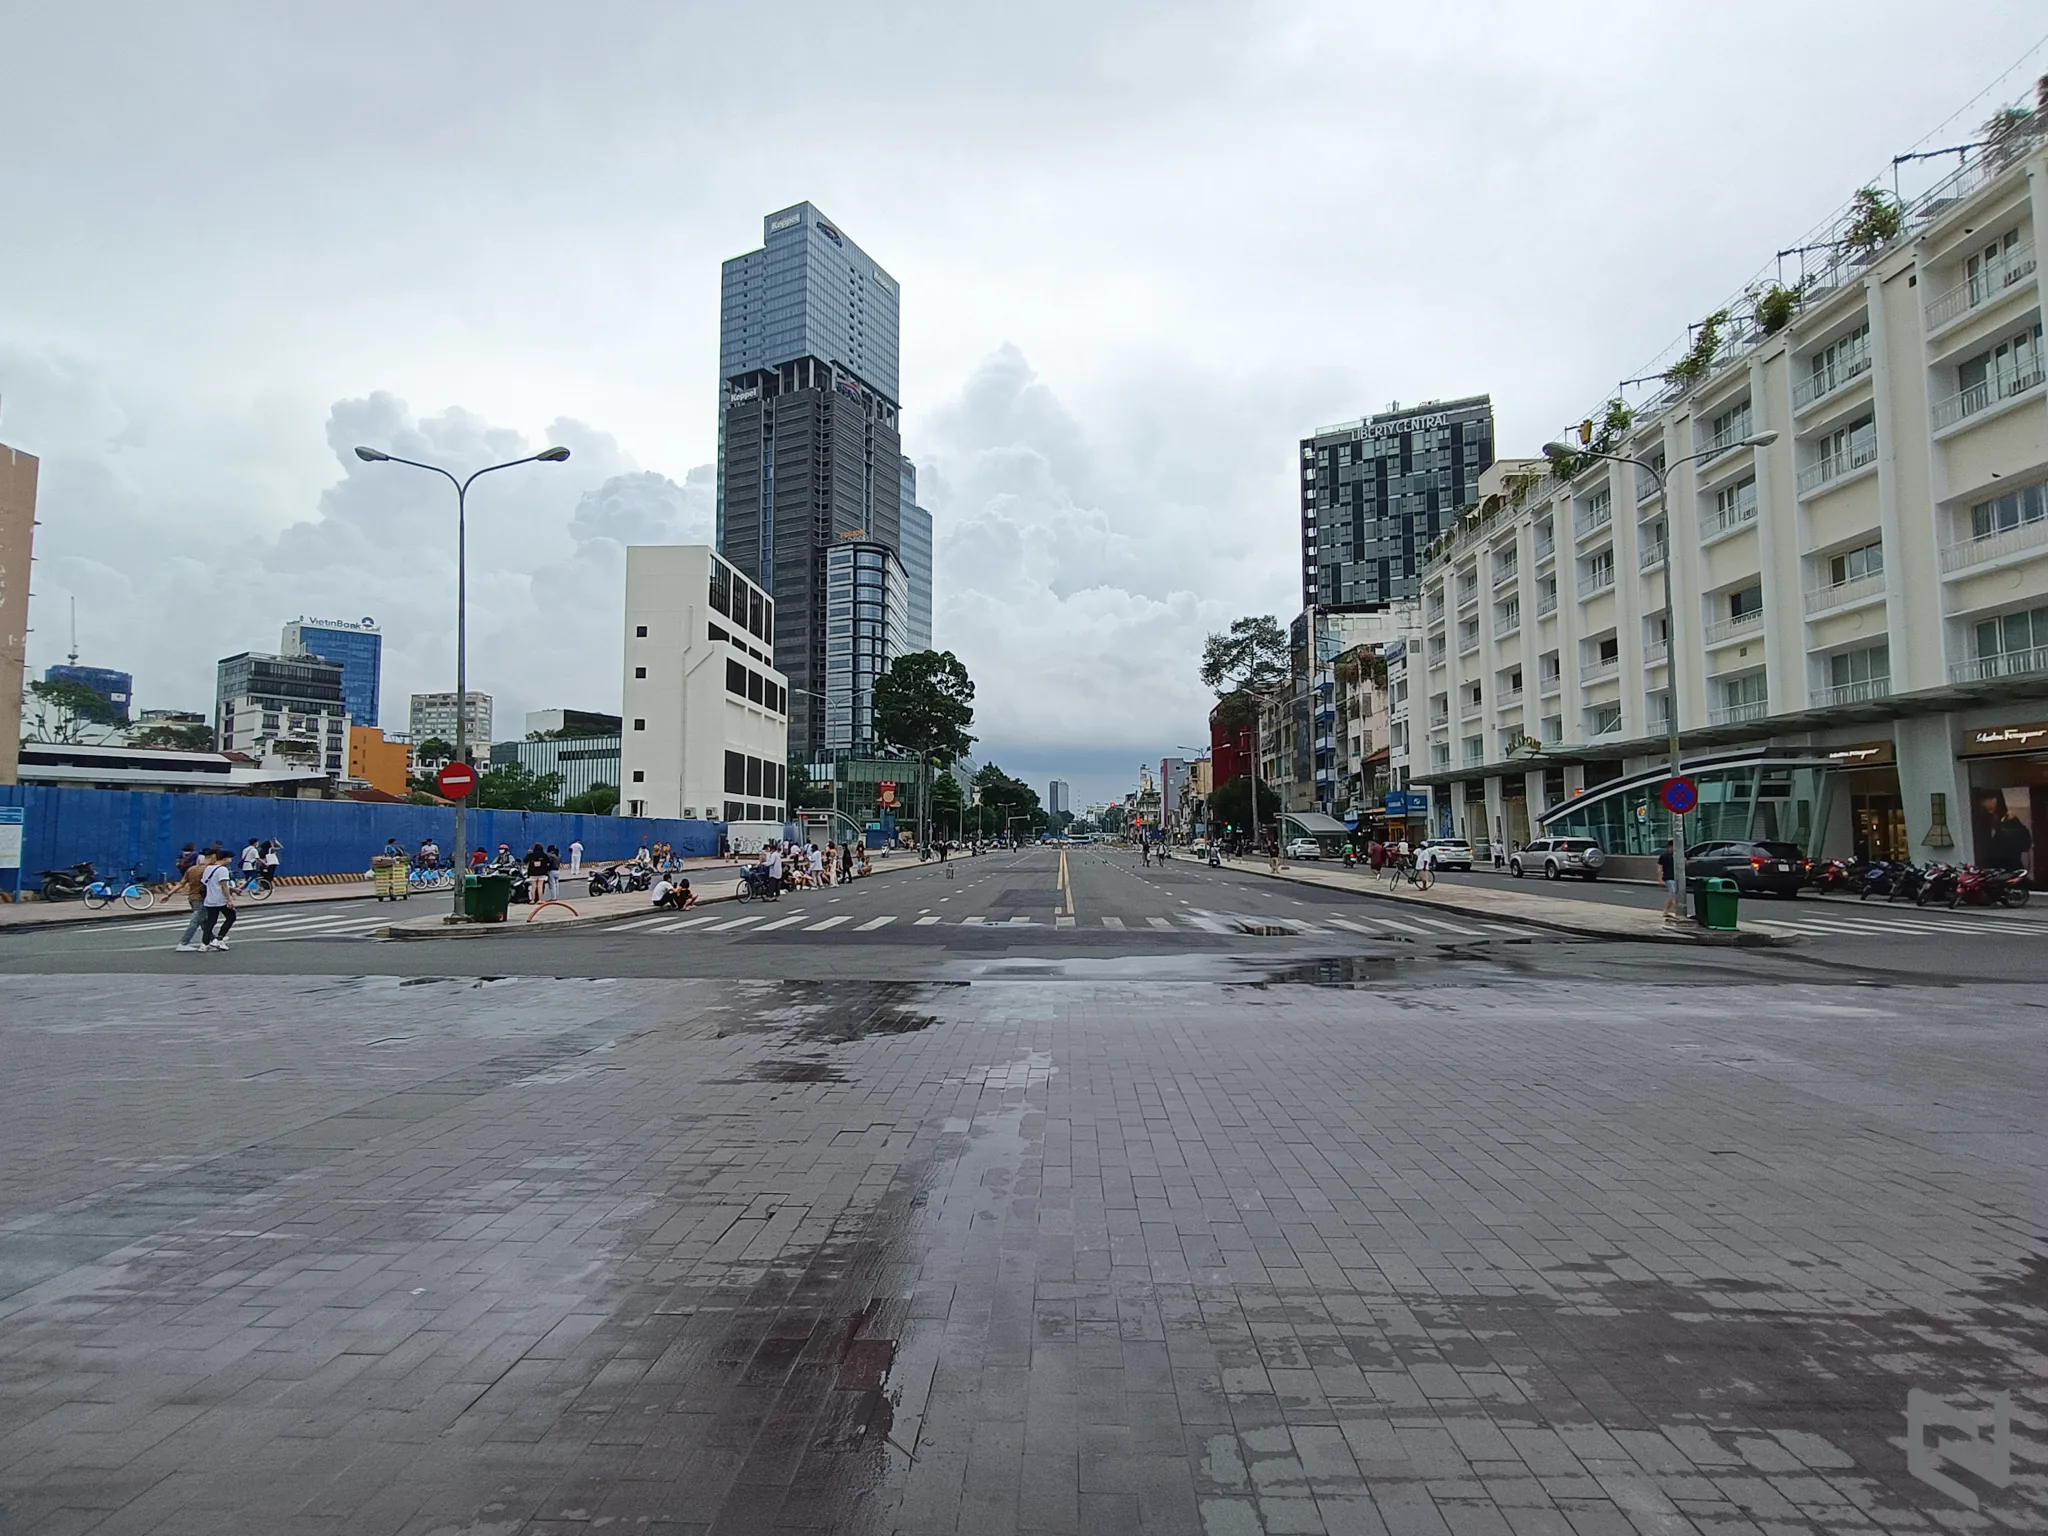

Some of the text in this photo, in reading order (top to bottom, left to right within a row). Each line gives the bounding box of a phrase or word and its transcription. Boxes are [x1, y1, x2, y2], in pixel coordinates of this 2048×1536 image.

[771, 213, 801, 230] Keppel
[731, 387, 757, 402] Keppel
[1351, 415, 1450, 441] LIBERTY CENTRAL
[309, 616, 361, 629] VietinBank
